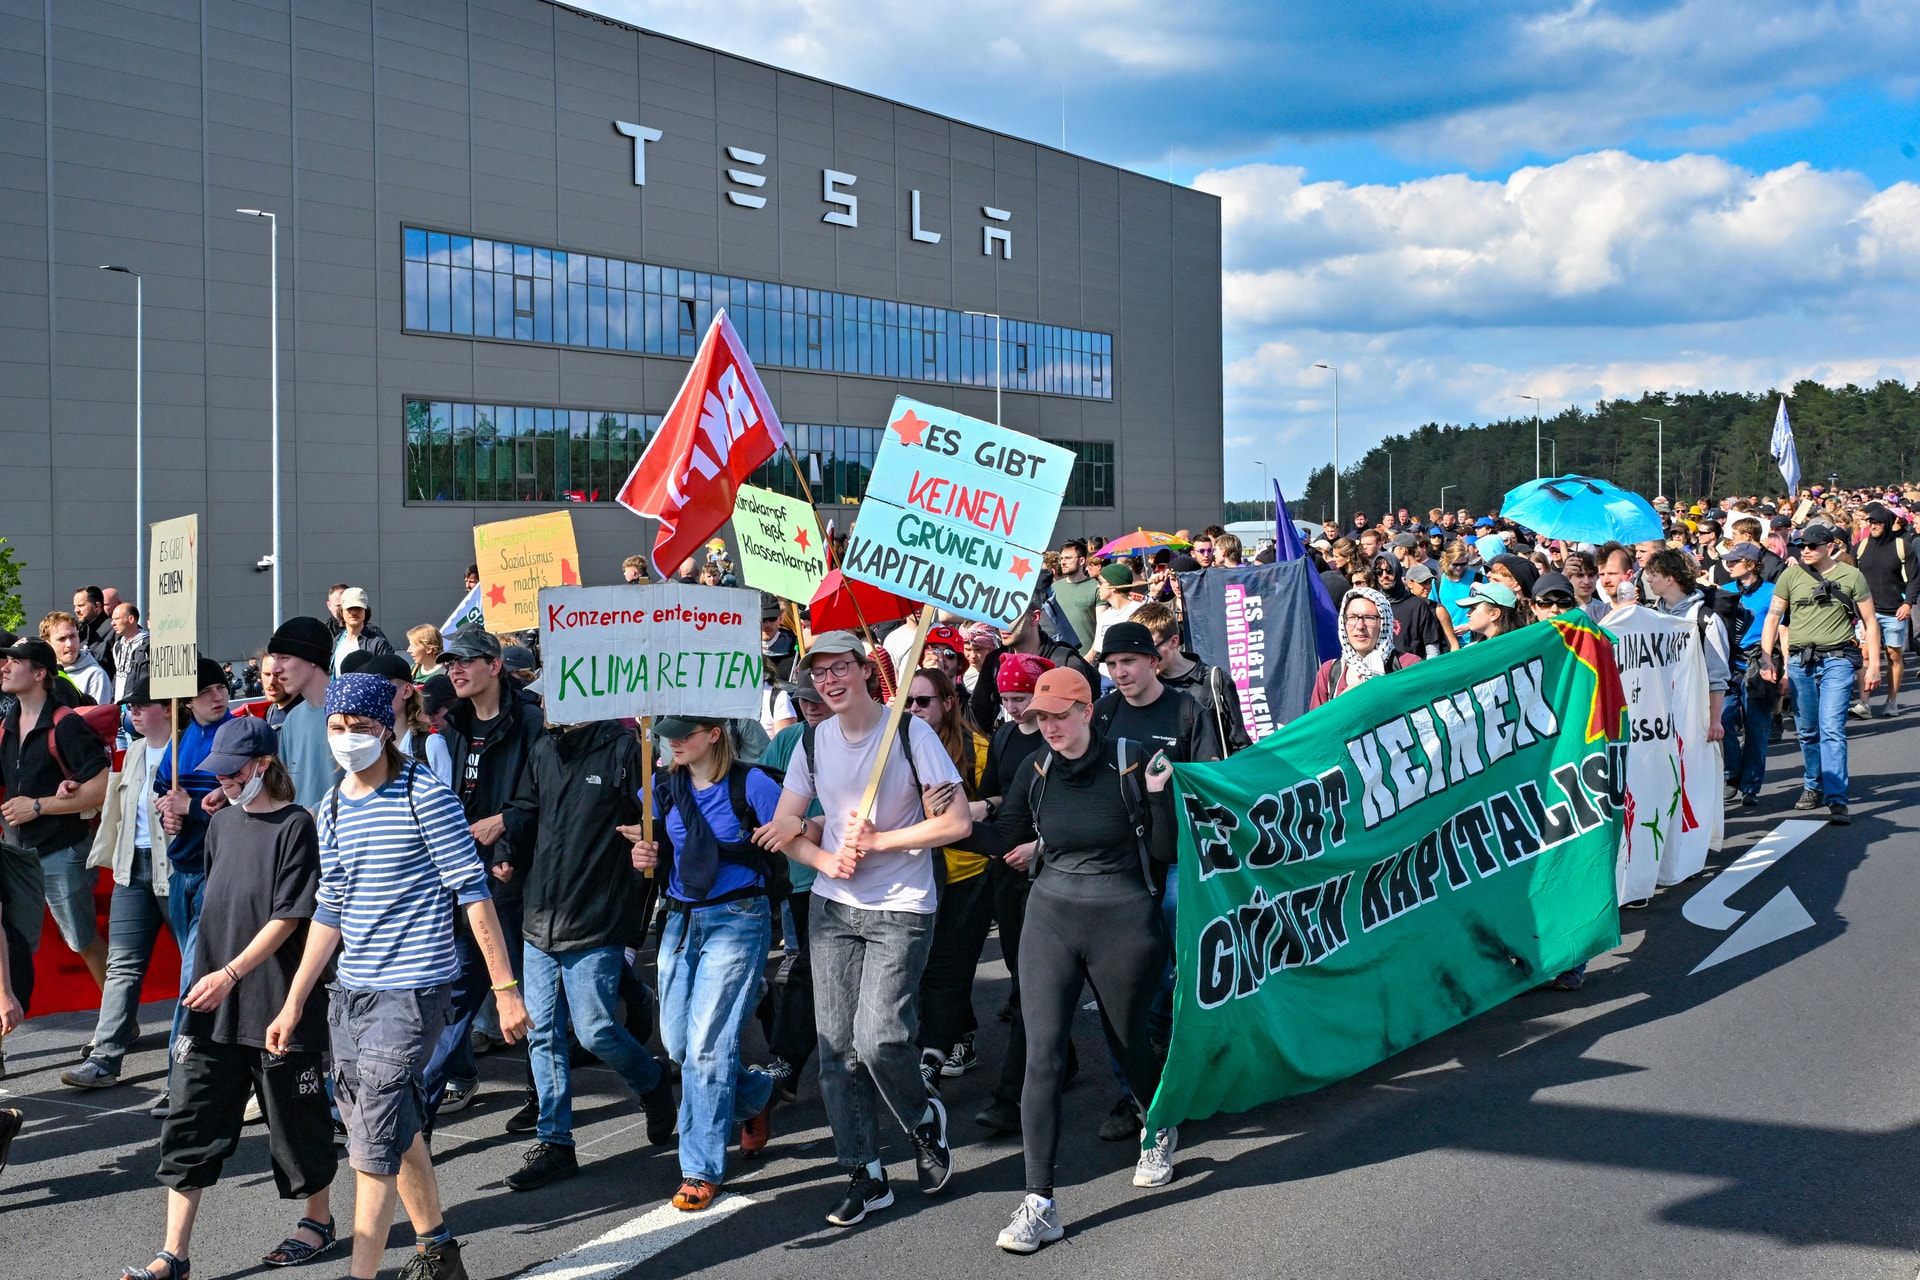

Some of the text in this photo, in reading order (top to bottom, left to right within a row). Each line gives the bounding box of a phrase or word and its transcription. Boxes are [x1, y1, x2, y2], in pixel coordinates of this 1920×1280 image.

[615, 120, 1012, 259] TESLA
[925, 424, 1046, 479] ES GIBT
[735, 493, 787, 521] limakampf
[907, 470, 1020, 537] KEINEN
[159, 536, 185, 562] ES GIBT
[758, 518, 786, 543] heißt
[896, 514, 1003, 570] GRÜNEN
[500, 545, 554, 571] Sozialismus
[513, 567, 548, 591] macht's
[845, 535, 1028, 624] KAPITALISMUS
[158, 569, 183, 596] KEINEN
[514, 593, 539, 621] mögli
[548, 603, 742, 632] Konzerne enteignen
[1243, 595, 1264, 622] ES
[1224, 588, 1248, 682] RUHIGES
[1247, 629, 1265, 679] GIBT
[1617, 632, 1691, 675] LIMAKAMPF
[559, 650, 763, 701] KLIMA RETTEN
[1246, 765, 1350, 869] GIBT
[1344, 655, 1561, 832] KEINEN
